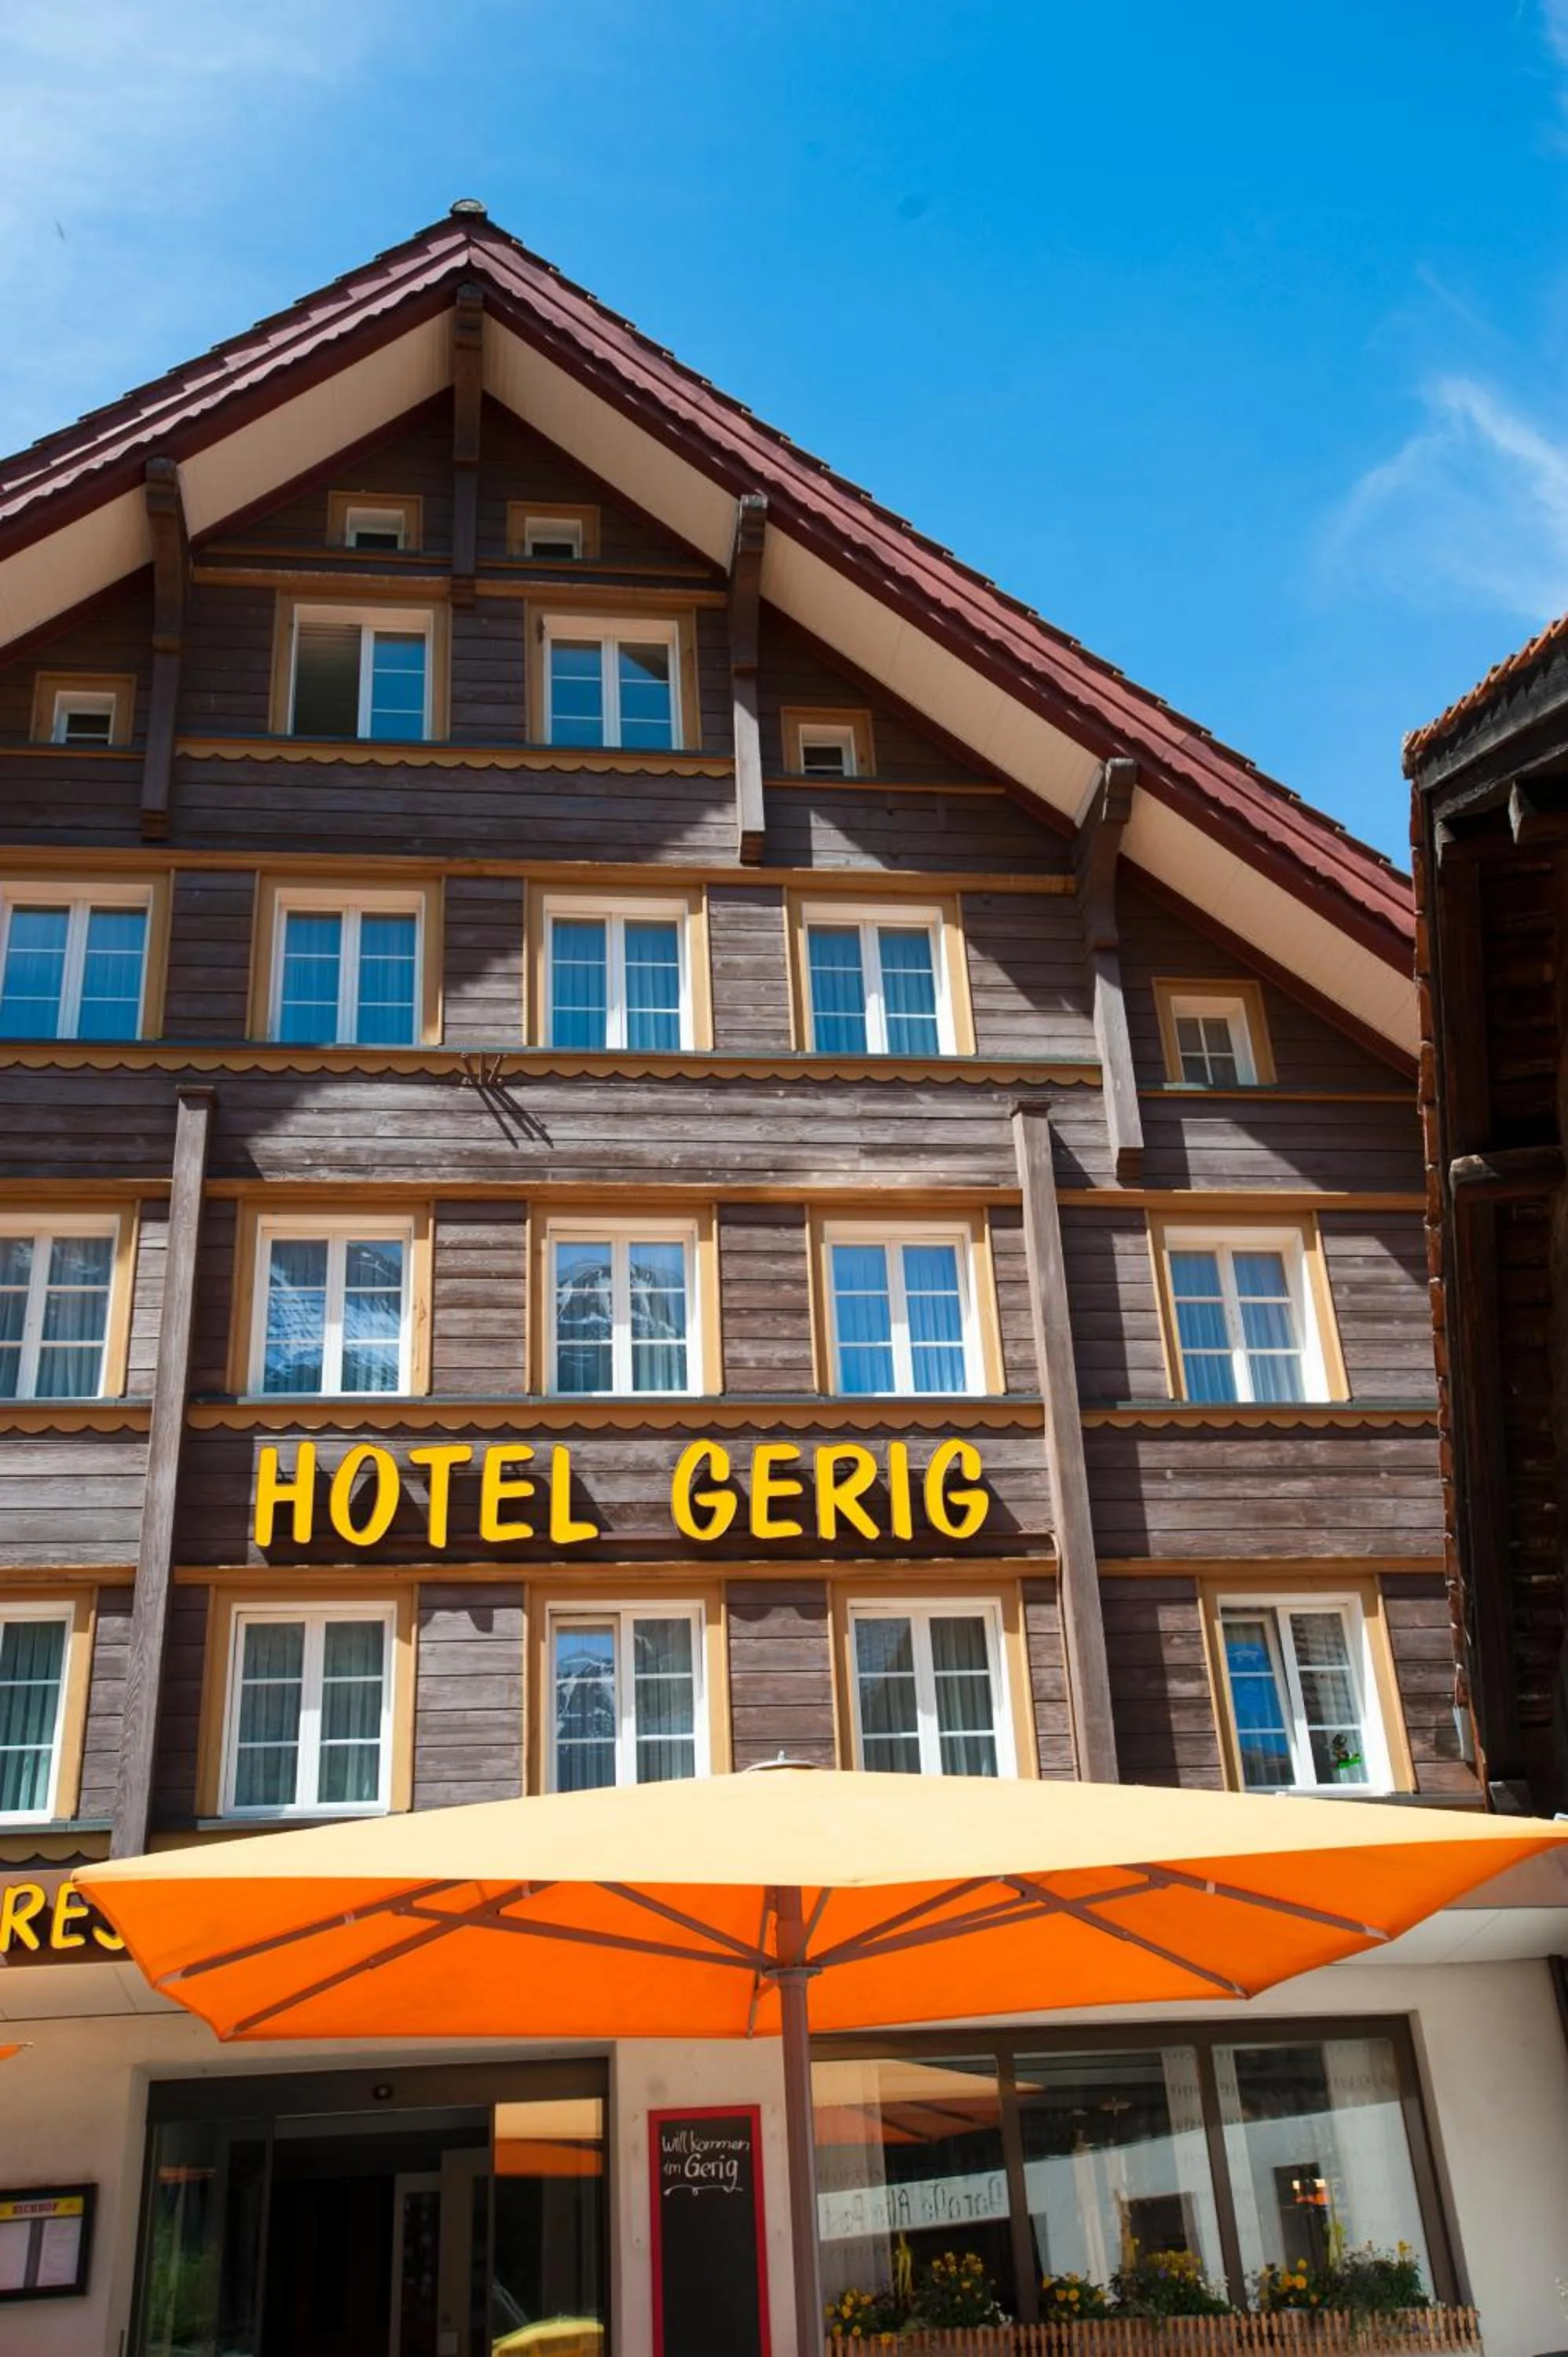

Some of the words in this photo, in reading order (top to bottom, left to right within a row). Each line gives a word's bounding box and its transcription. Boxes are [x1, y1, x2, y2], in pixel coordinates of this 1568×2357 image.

[254, 1442, 599, 1548] HOTEL
[672, 1437, 989, 1540] GERIG
[684, 2154, 739, 2191] Gerig
